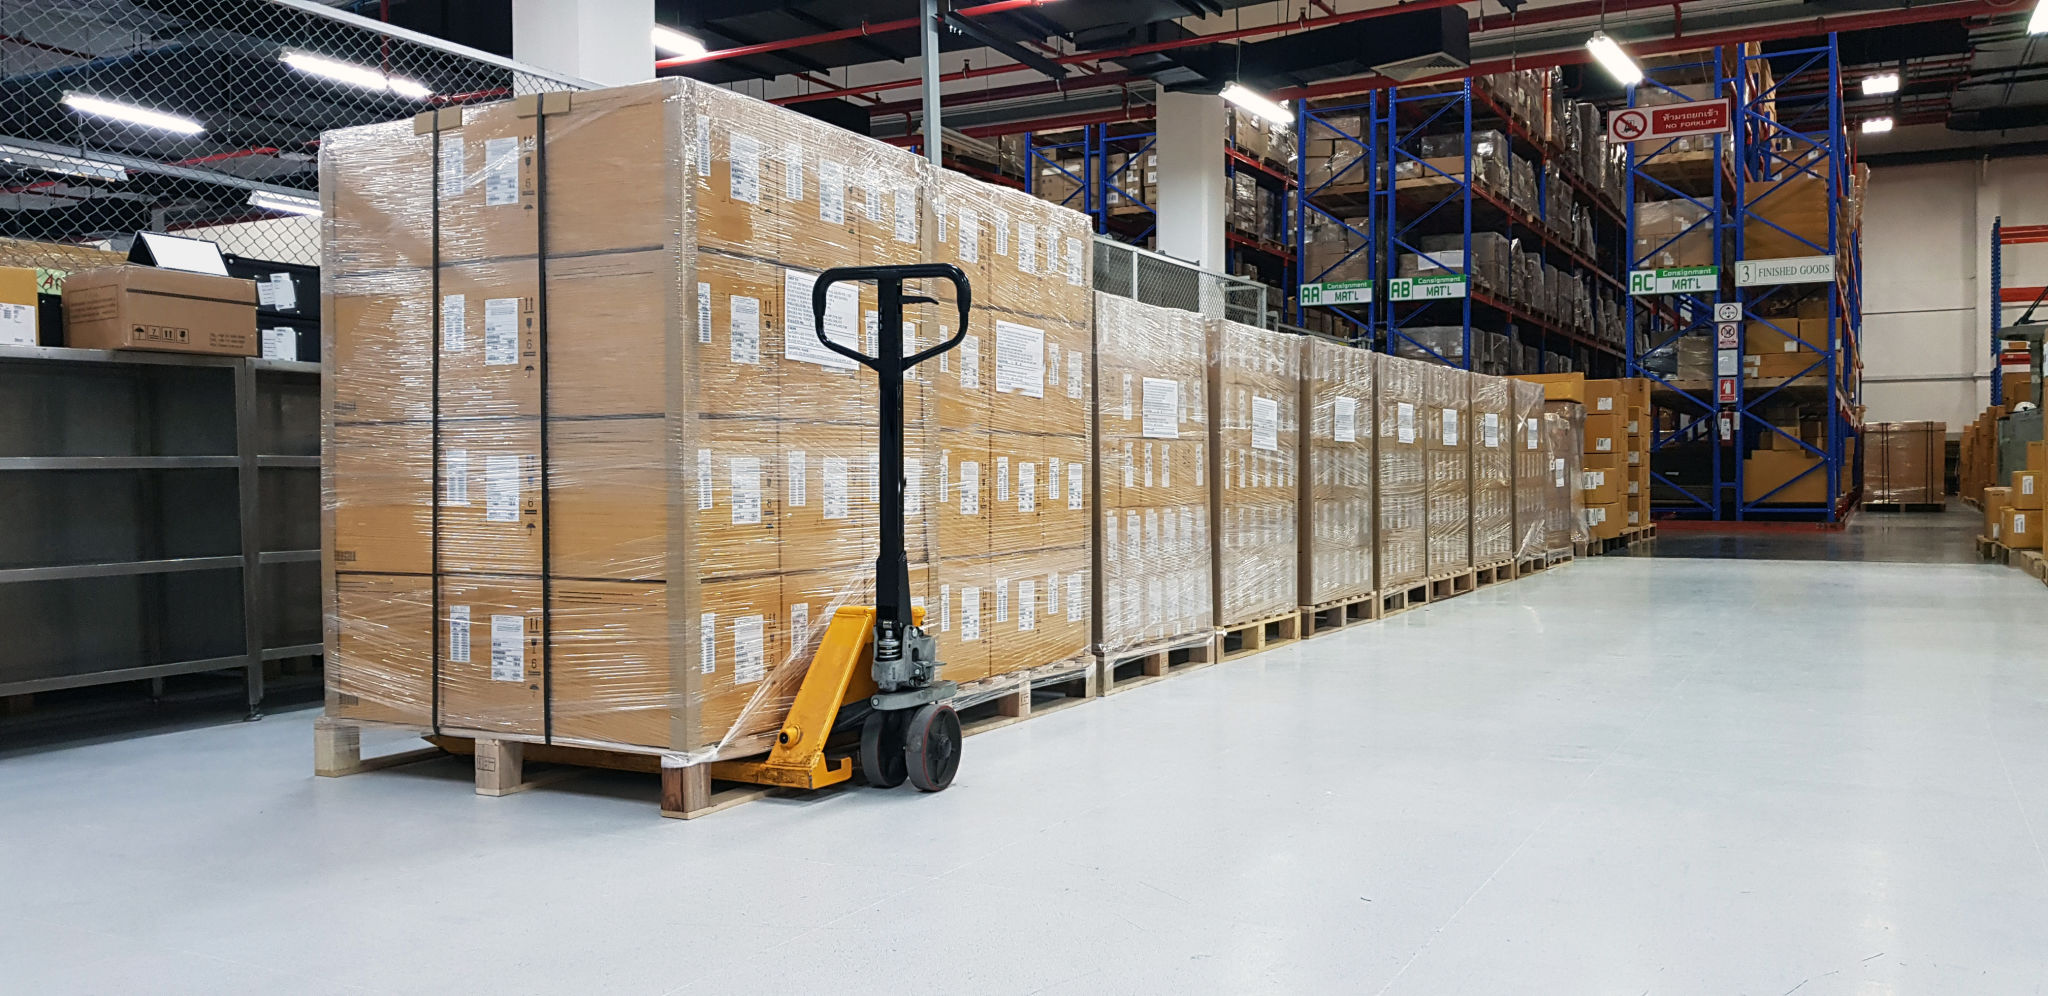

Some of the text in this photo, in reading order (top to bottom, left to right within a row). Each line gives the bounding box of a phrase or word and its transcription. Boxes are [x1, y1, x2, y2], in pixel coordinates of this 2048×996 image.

[1680, 119, 1718, 128] FORKLIFT
[1662, 268, 1711, 277] Consignment
[1742, 264, 1830, 282] 3 FINISHED GOODS
[1417, 276, 1461, 284] Consignment
[1632, 274, 1654, 291] AC
[1672, 278, 1701, 290] MAT'L
[1302, 286, 1320, 303] AA
[1391, 281, 1411, 298] AB
[1426, 285, 1452, 296] MAT'L
[1334, 291, 1359, 301] MAT'L
